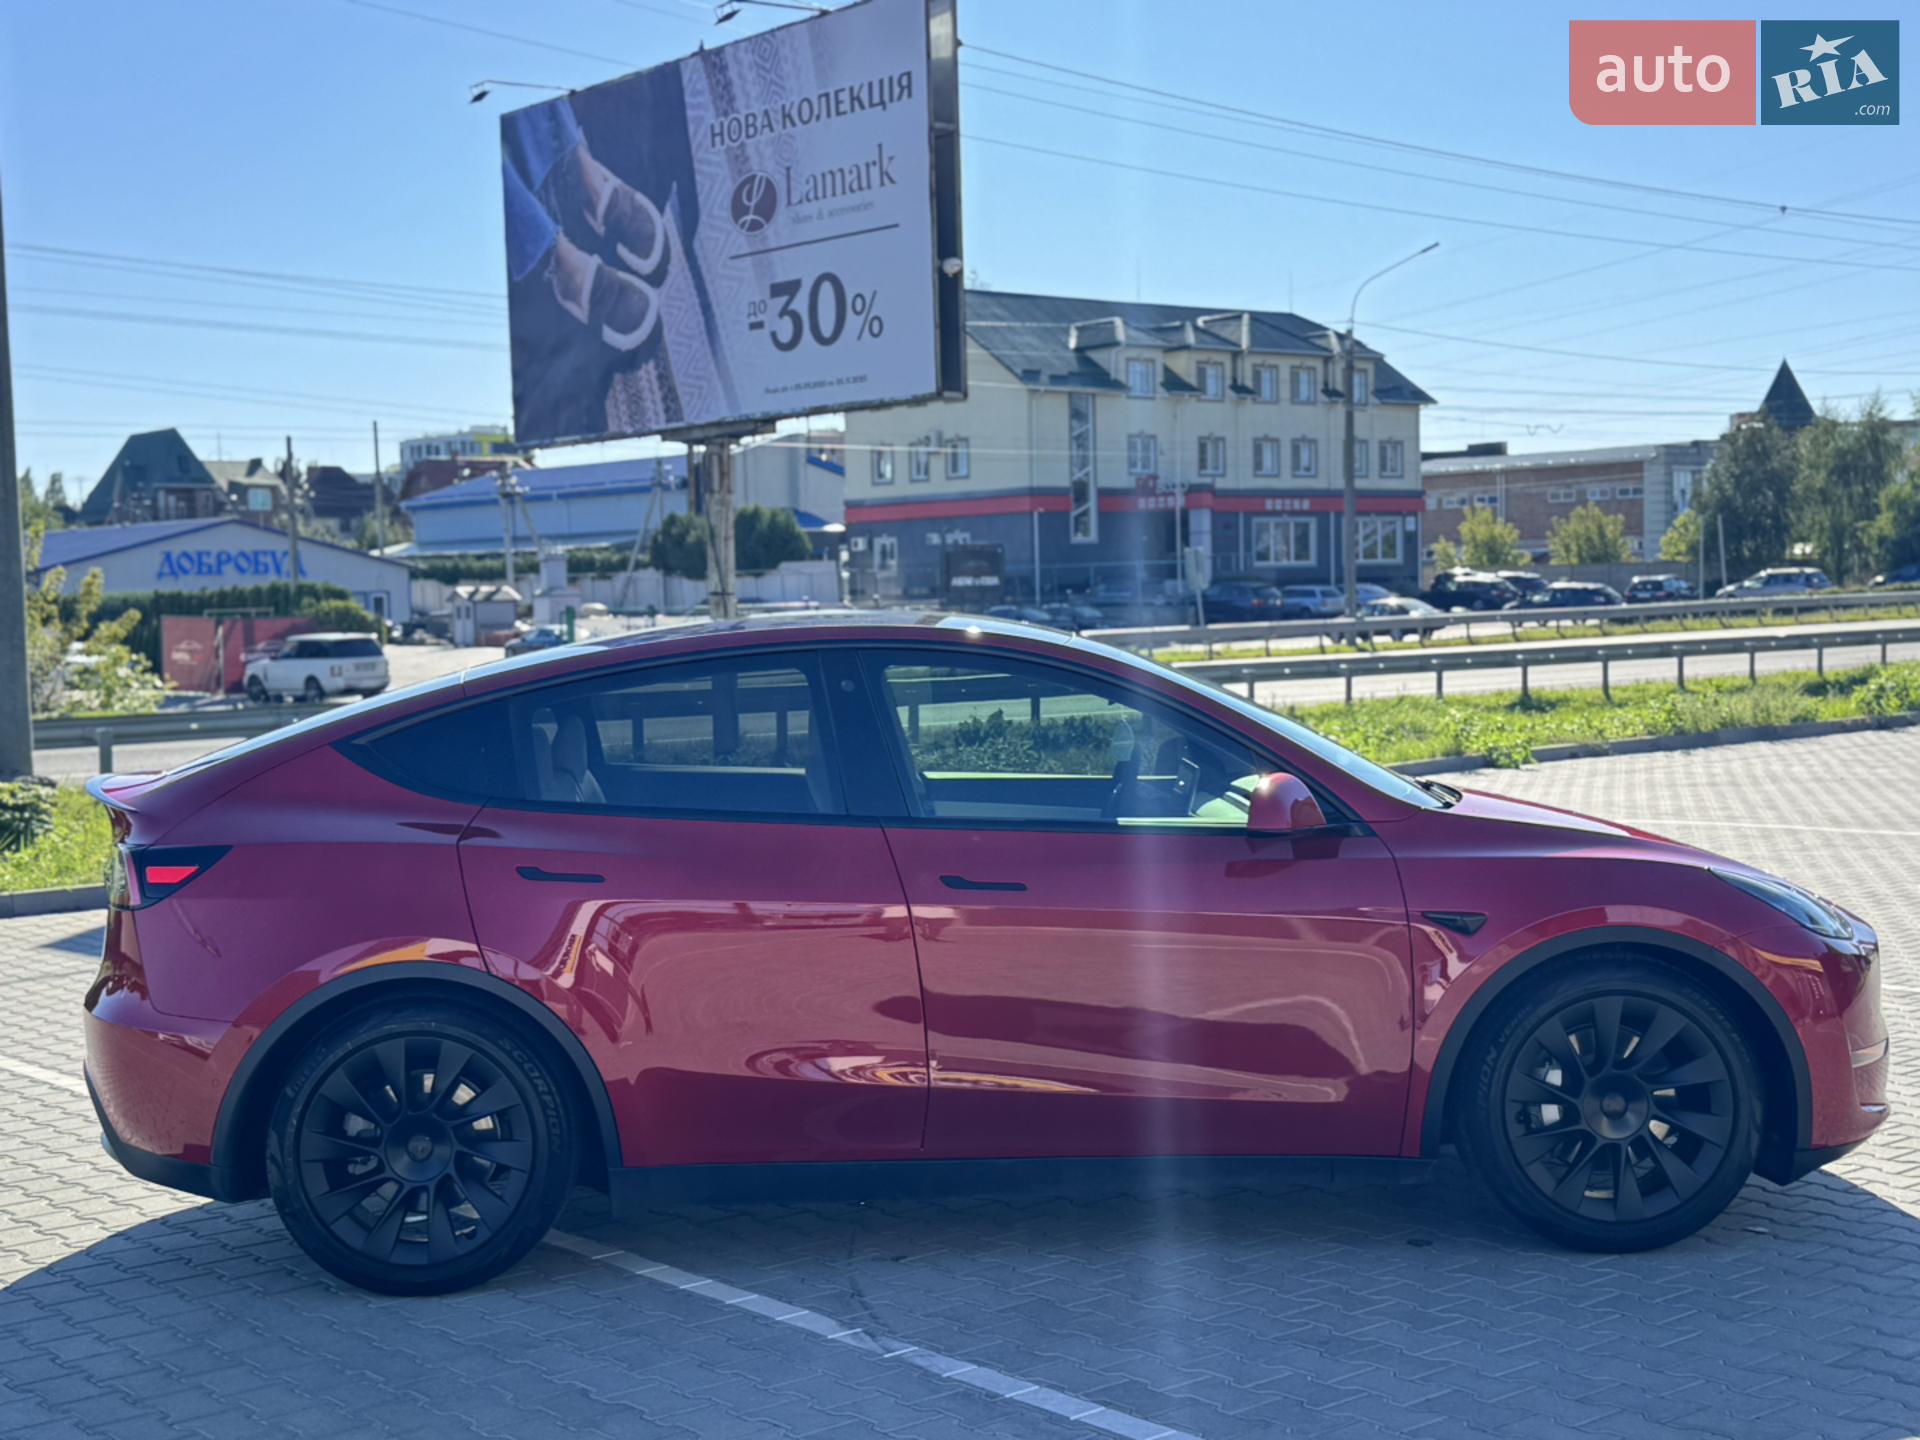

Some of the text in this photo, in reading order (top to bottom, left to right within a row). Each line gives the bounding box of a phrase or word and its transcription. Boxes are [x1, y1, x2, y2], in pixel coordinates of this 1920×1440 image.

[710, 70, 913, 149] НОВА КОЛЕКЦІЯ
[785, 143, 898, 208] Lamark
[748, 271, 884, 353] -30%
[498, 1038, 562, 1154] SCORPION
